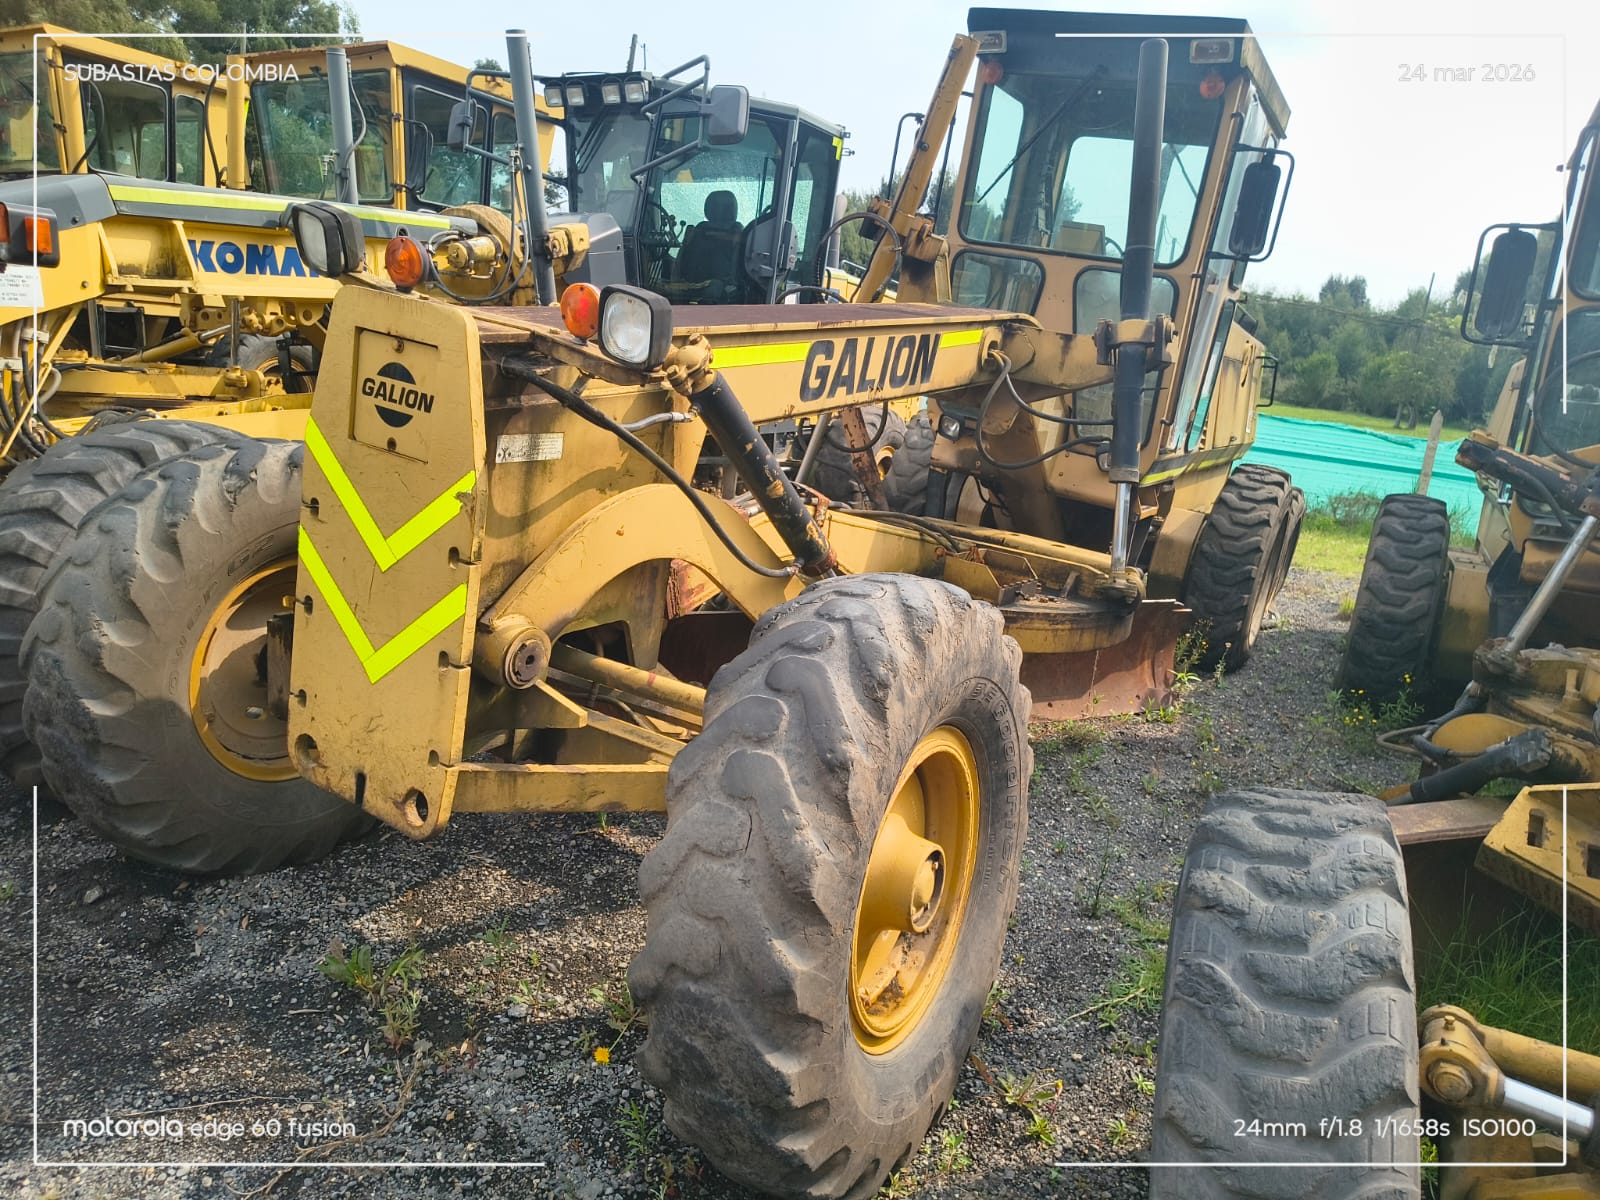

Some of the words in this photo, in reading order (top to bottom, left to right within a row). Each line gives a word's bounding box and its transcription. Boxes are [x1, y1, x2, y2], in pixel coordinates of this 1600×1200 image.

[189, 239, 320, 278] KOMA
[799, 332, 941, 403] GALION
[361, 377, 434, 413] GALION
